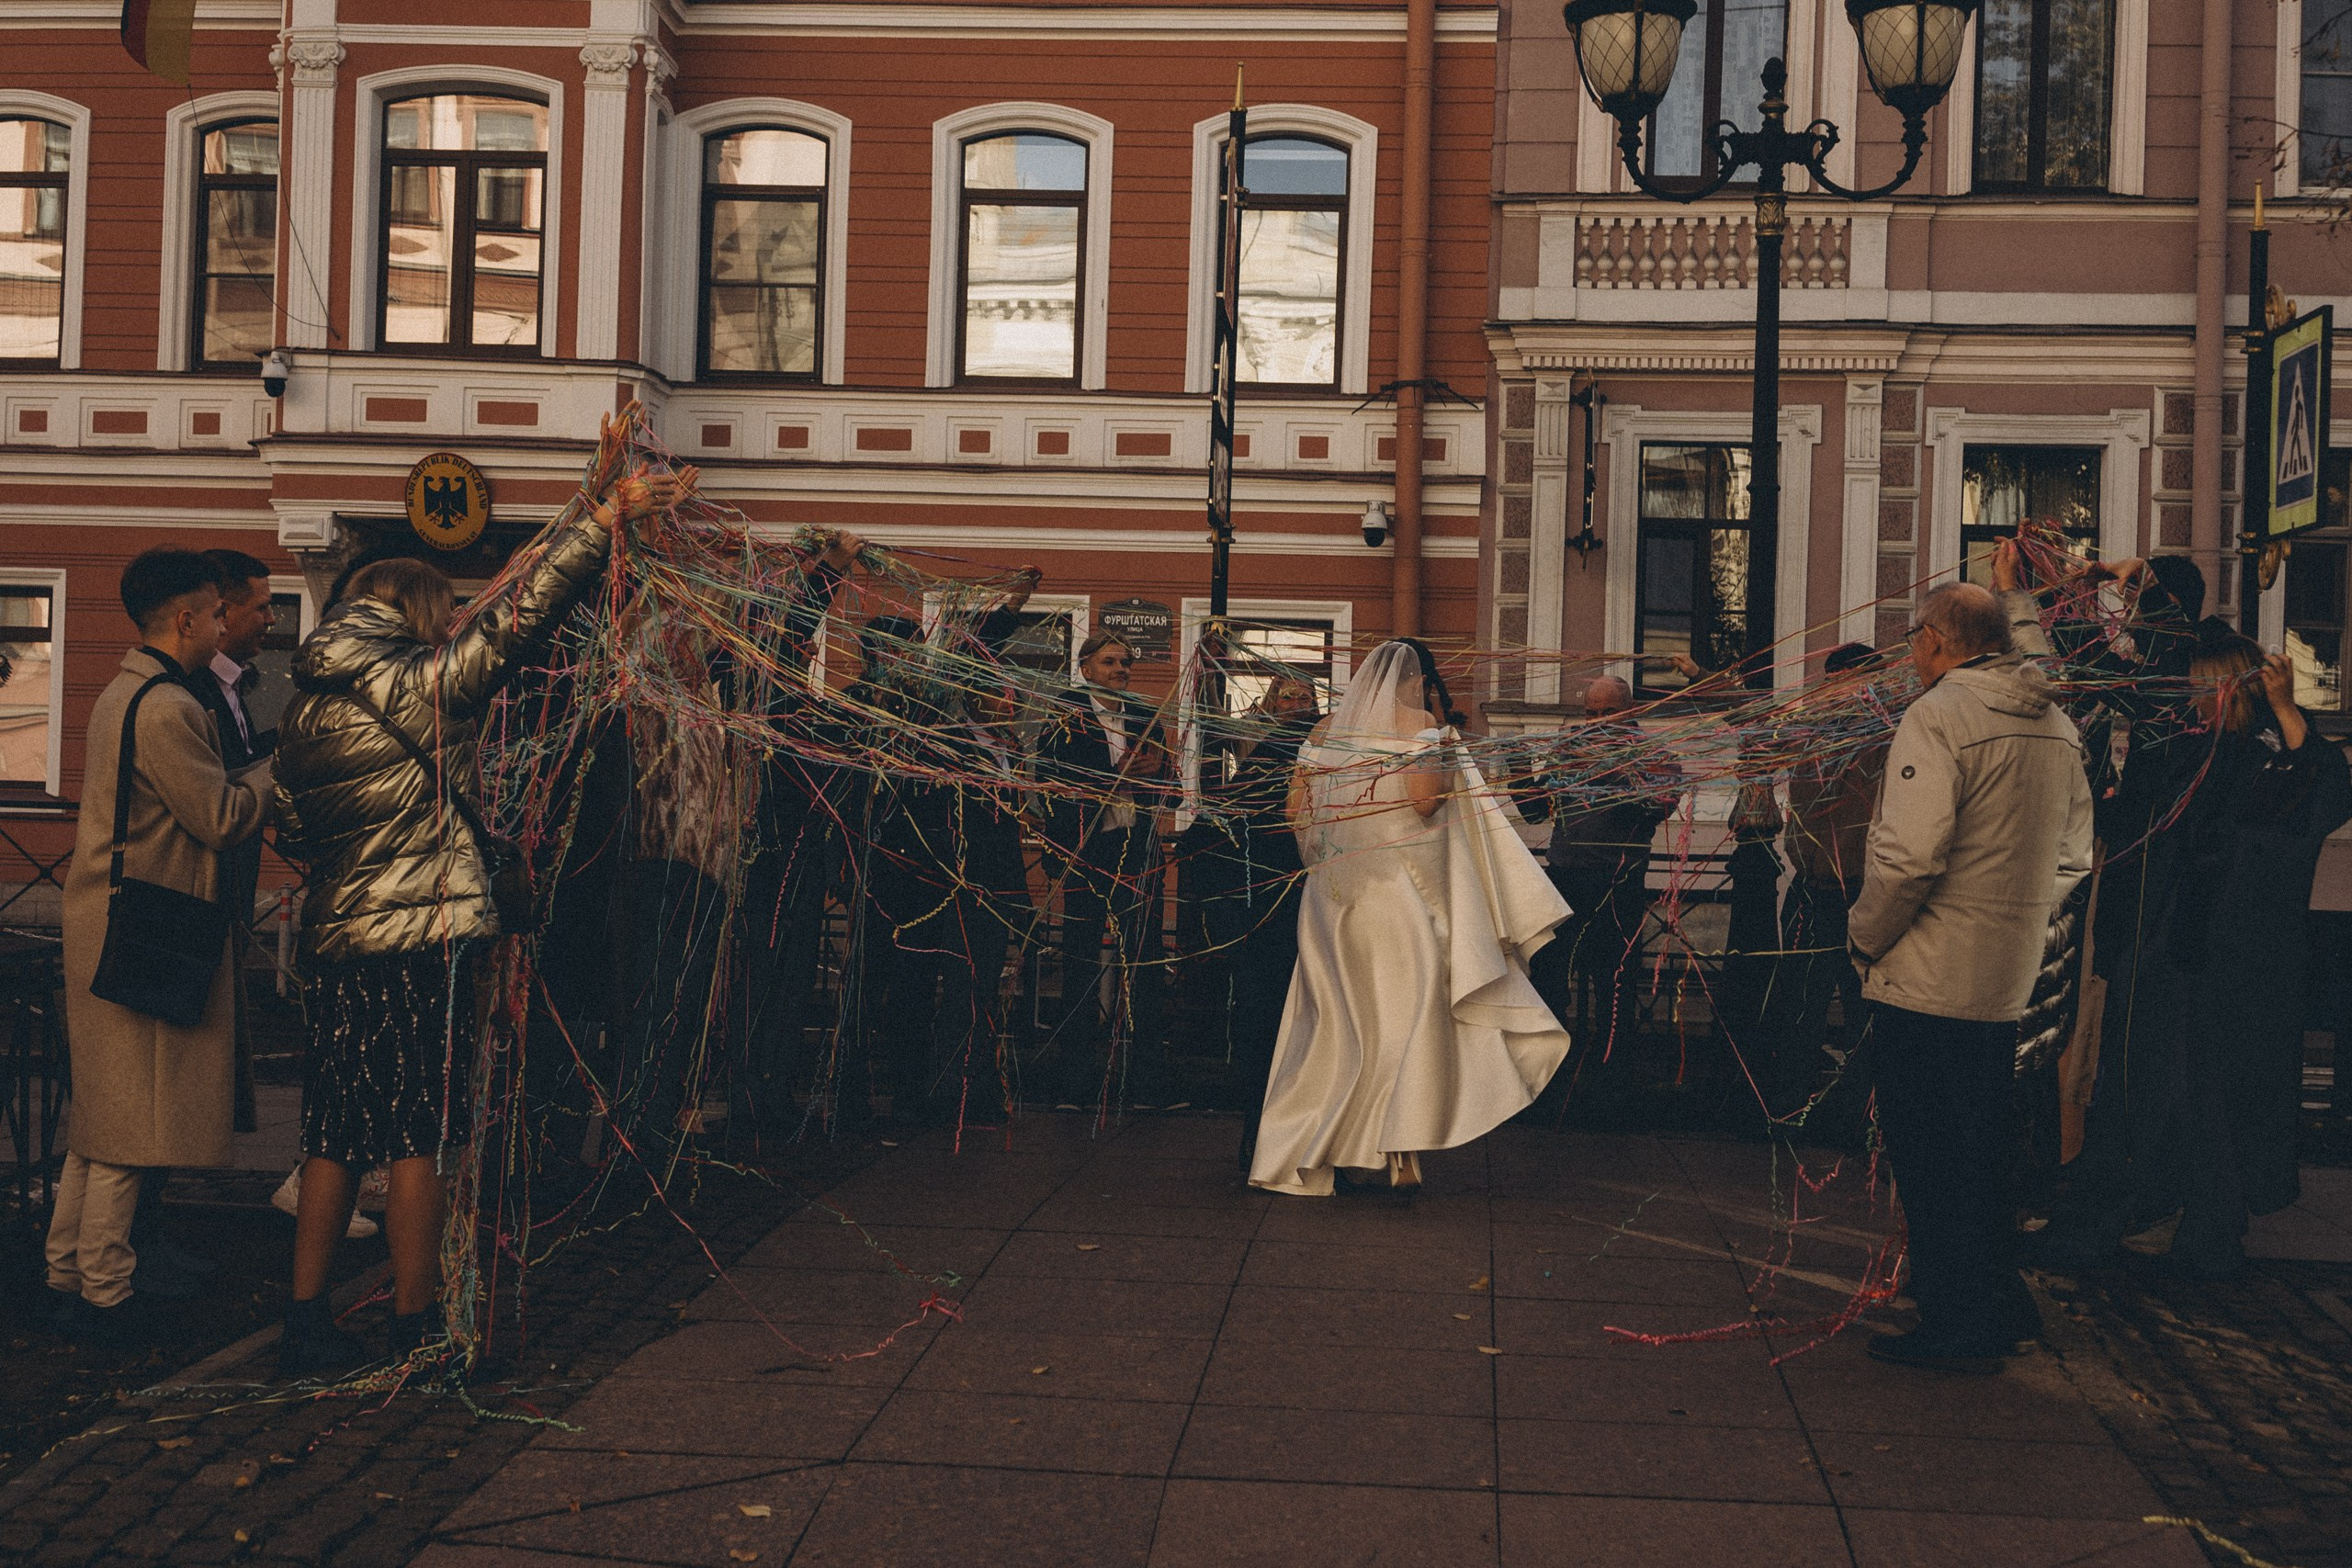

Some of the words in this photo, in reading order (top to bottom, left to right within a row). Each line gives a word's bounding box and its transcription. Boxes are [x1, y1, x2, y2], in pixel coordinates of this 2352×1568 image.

[407, 455, 450, 508] BUNDESREPUBLIK
[451, 456, 488, 510] DEUTSCHLAND
[1104, 615, 1167, 626] ФУРШТАТСКАЯ
